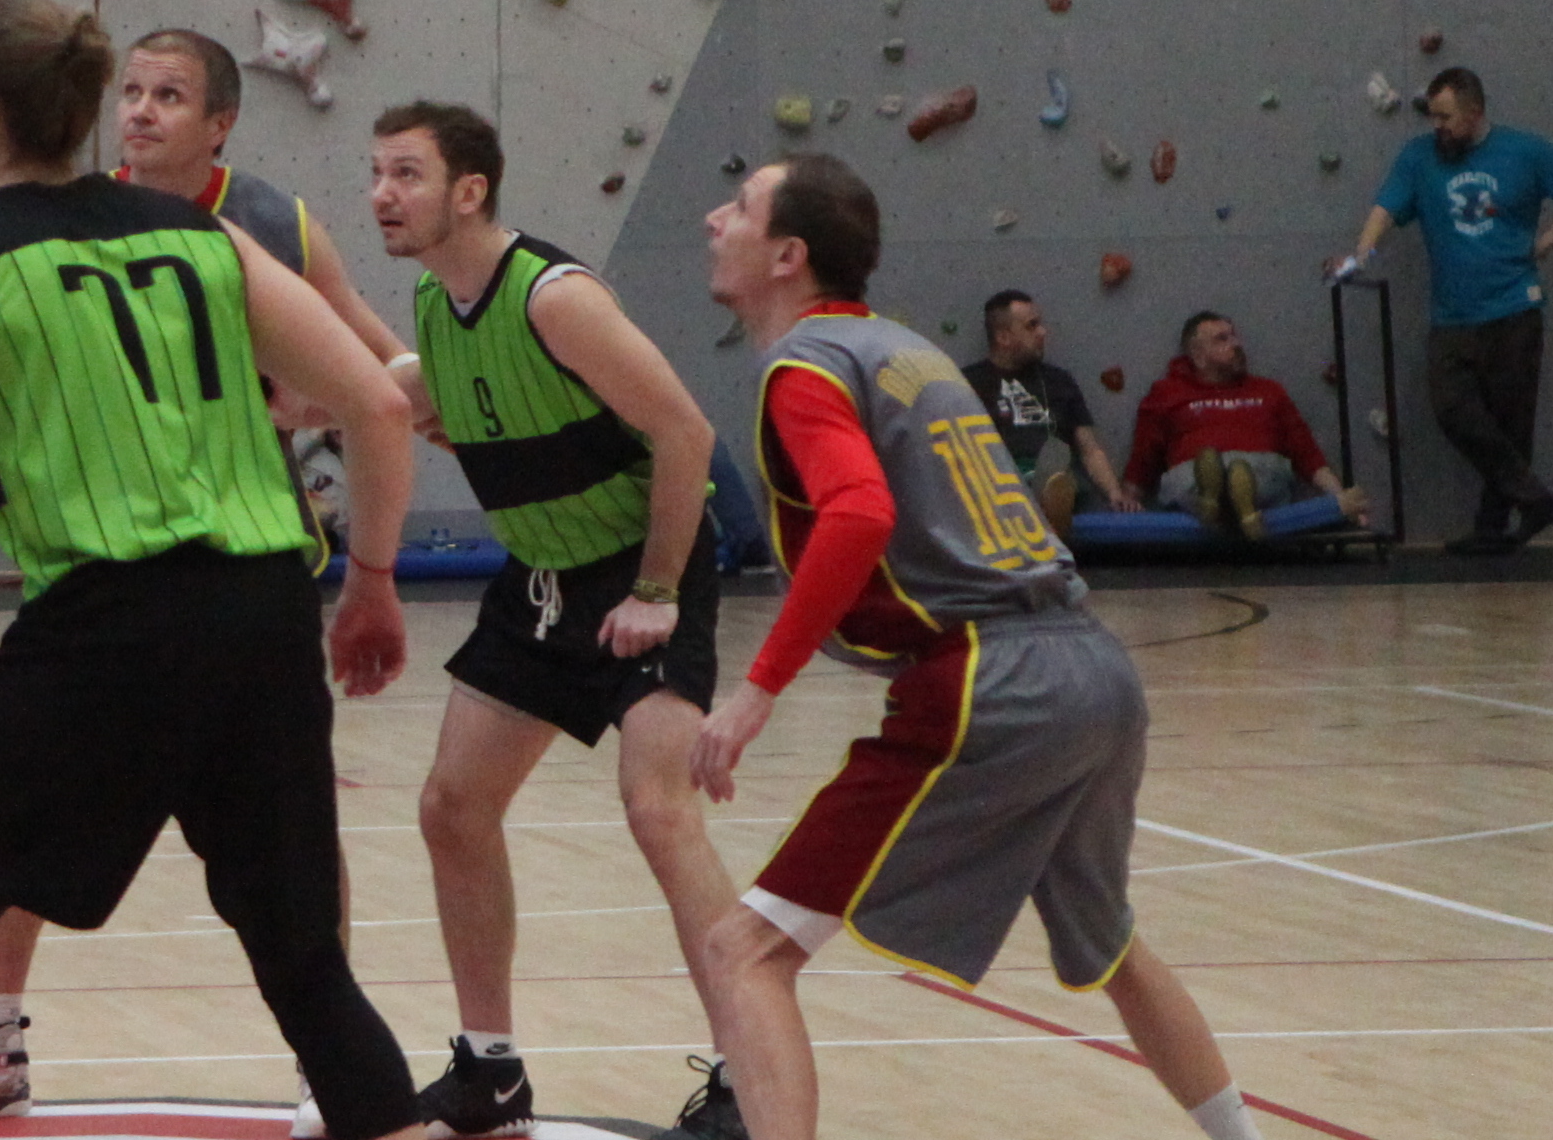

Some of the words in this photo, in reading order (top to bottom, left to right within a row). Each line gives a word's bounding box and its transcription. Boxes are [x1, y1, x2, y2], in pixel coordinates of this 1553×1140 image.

[57, 255, 224, 404] 77
[473, 377, 504, 438] 9
[927, 414, 1057, 571] 15
